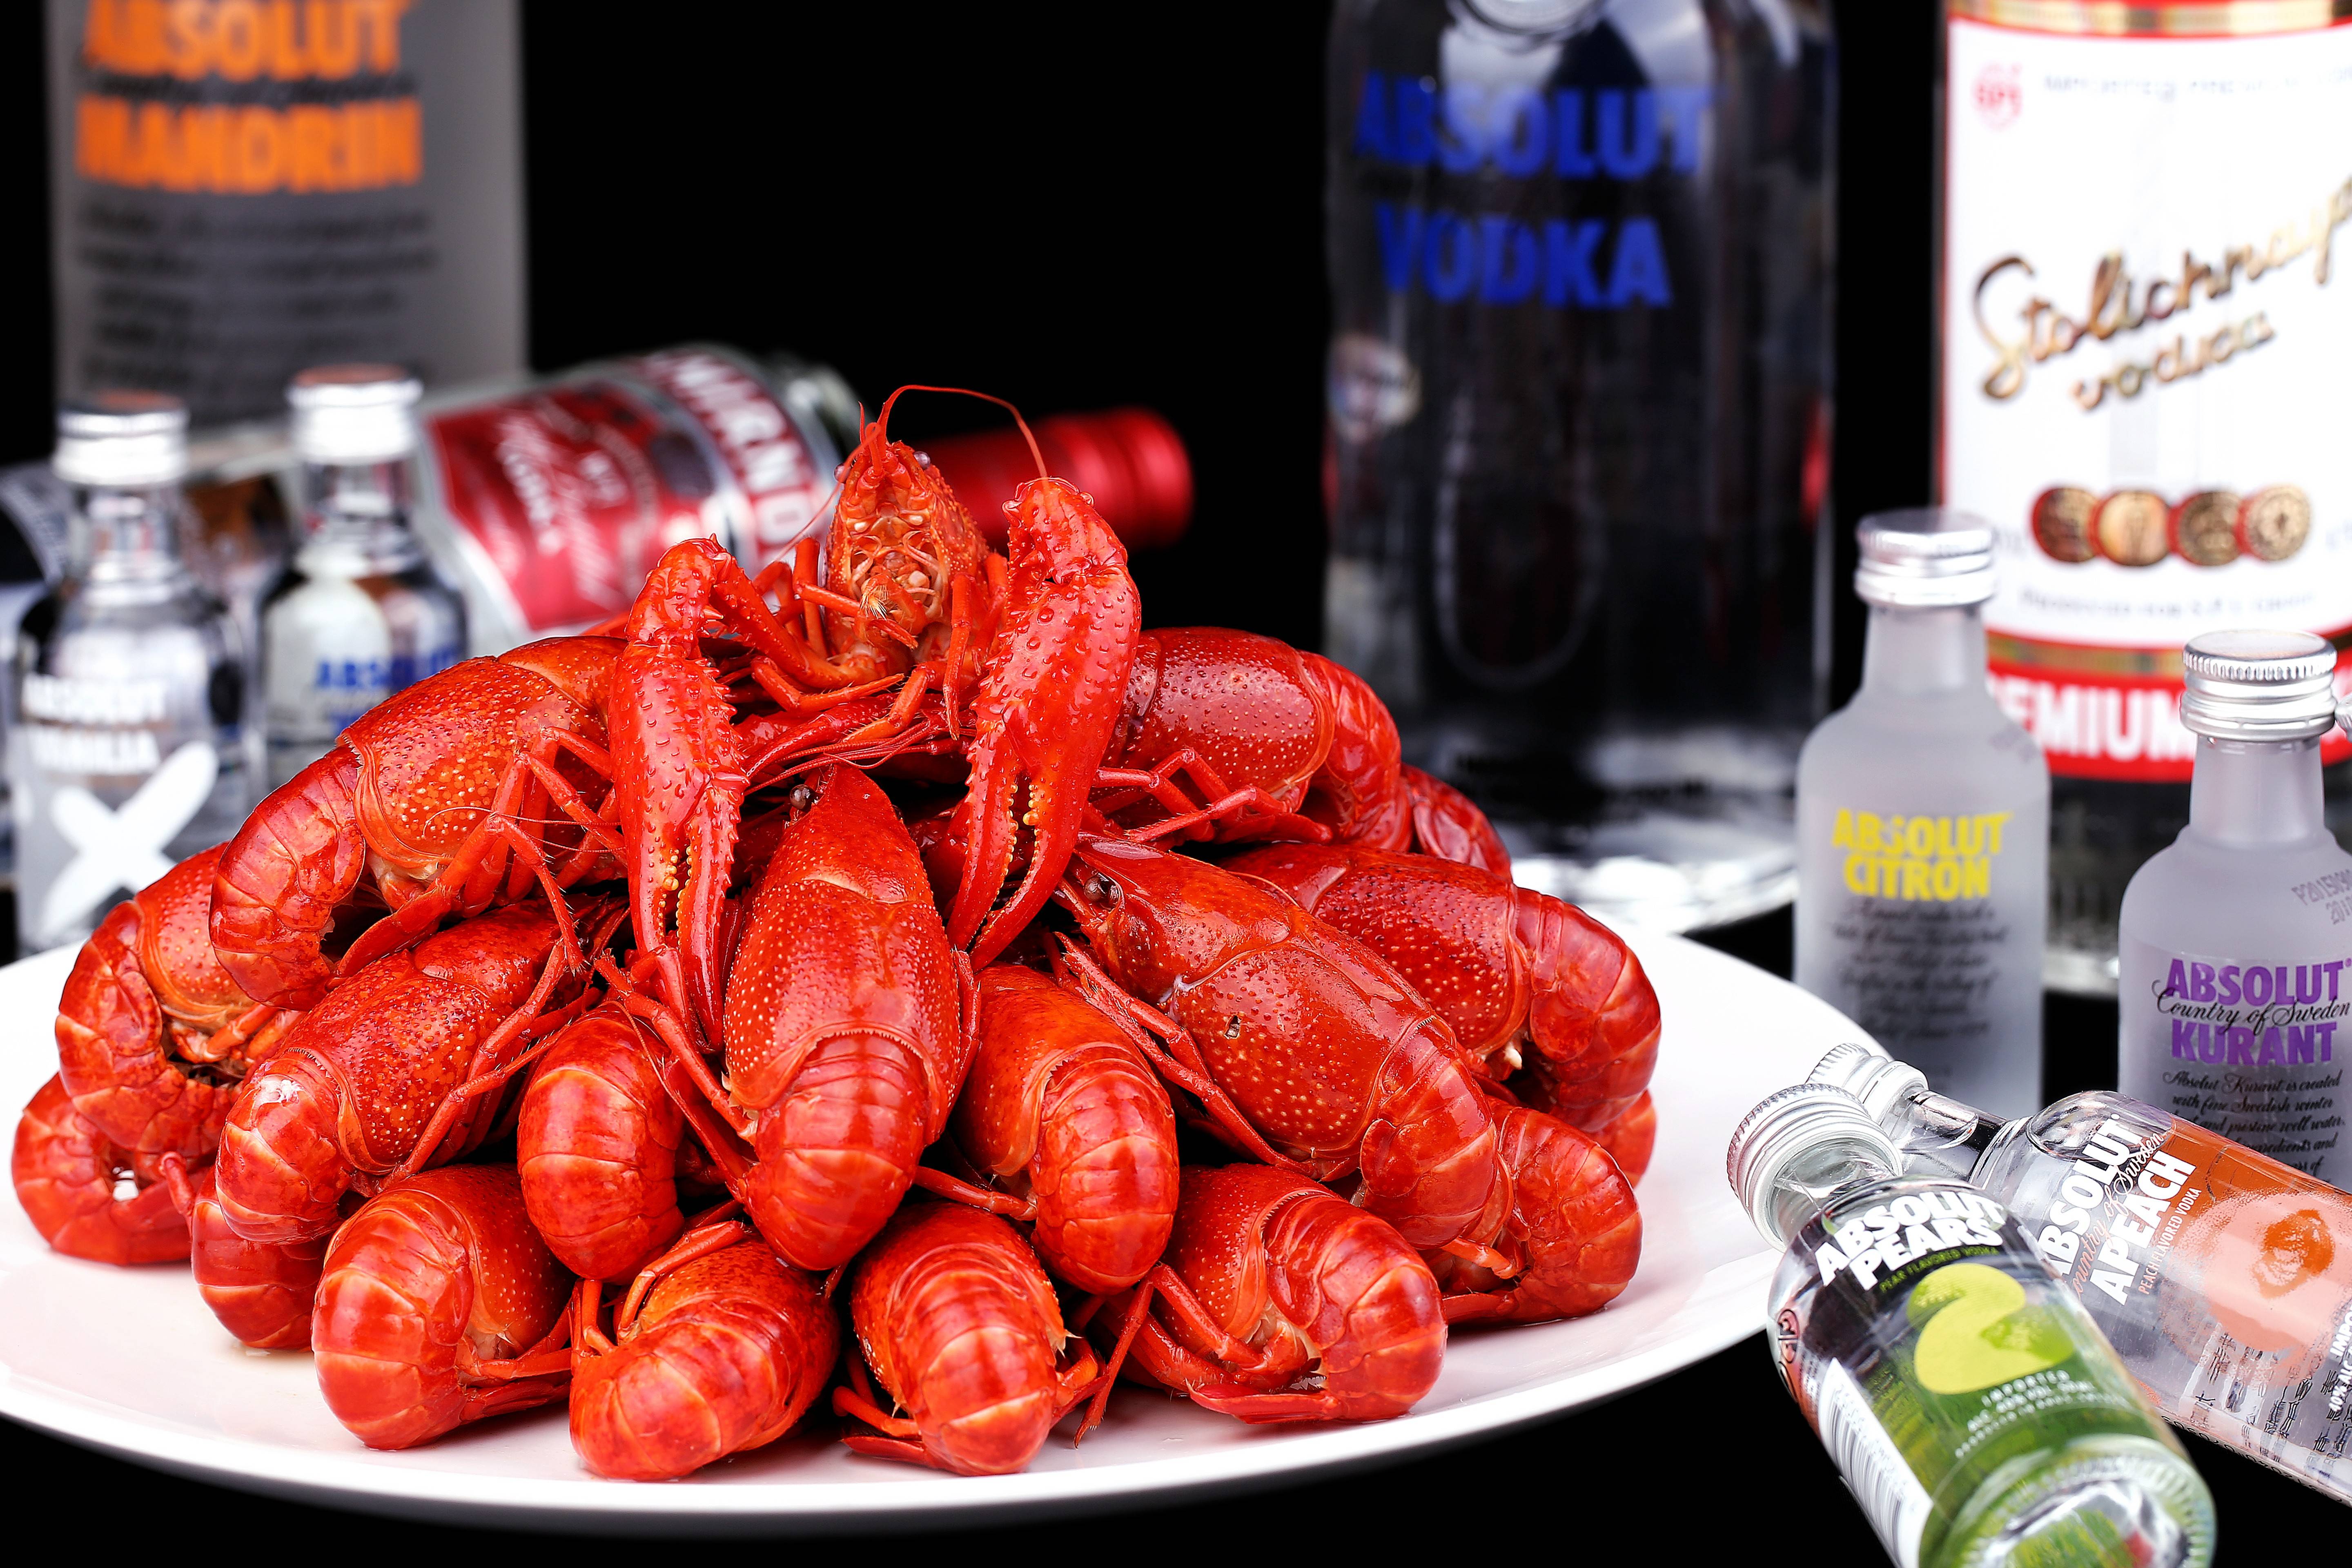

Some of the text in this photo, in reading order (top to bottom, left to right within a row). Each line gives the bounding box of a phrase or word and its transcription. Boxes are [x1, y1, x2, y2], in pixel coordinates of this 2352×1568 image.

[1355, 70, 1714, 180] ABSOLUT
[1375, 203, 1673, 309] VODKA
[1988, 672, 2195, 762] EMIUM
[1832, 808, 2013, 857] ABSOLUT
[1843, 854, 1991, 901] CITRON
[2152, 980, 2351, 1036] Country of Sweden
[2164, 958, 2343, 1006] ABSOLUT
[2171, 1018, 2337, 1066] KURANT
[2163, 1070, 2218, 1090] Absolut
[2221, 1073, 2281, 1095] Kurant
[2299, 1069, 2343, 1090] created
[1814, 1191, 2007, 1287] ABSOLUT
[2074, 1132, 2164, 1300] ountry of Sweden
[2089, 1150, 2196, 1305] APEACH
[2138, 1187, 2202, 1295] PEACH FLAVORED VODKA
[1849, 1217, 2003, 1291] PEARS
[2330, 1304, 2352, 1356] IMPO
